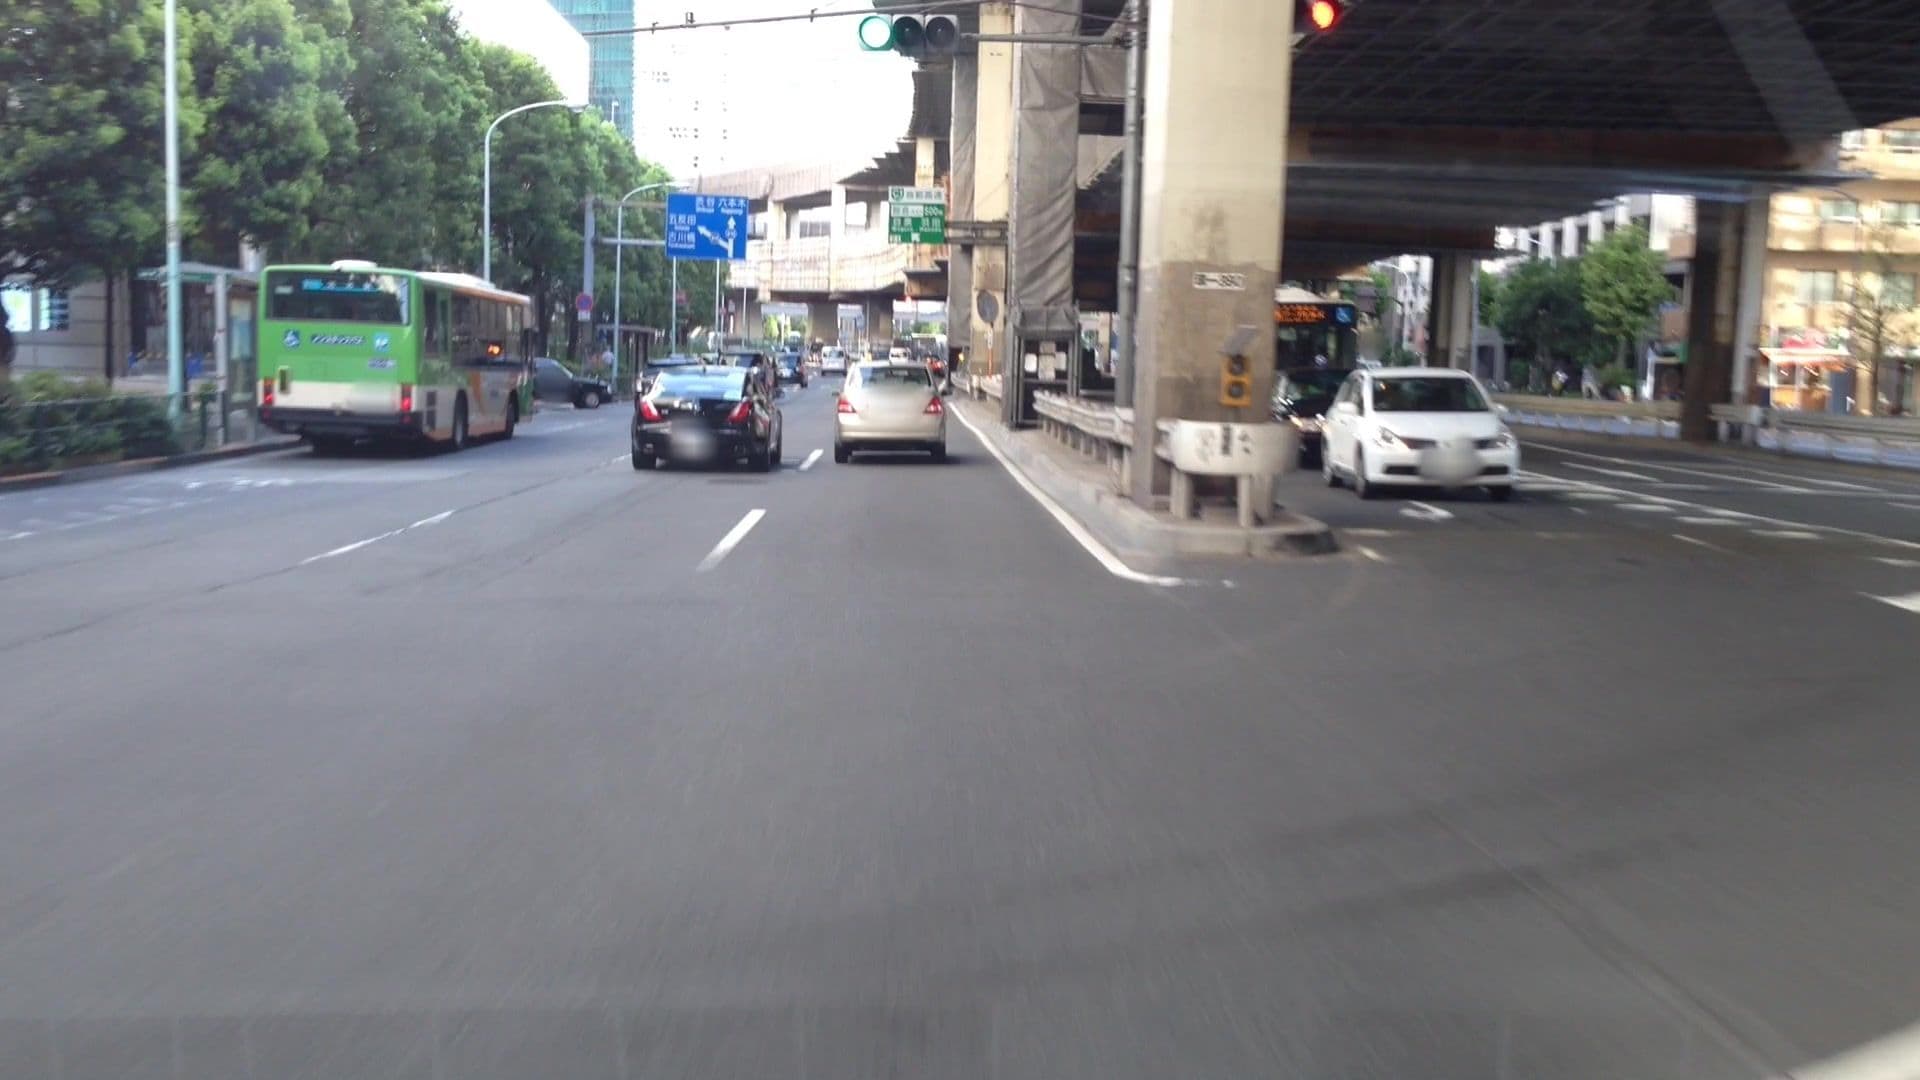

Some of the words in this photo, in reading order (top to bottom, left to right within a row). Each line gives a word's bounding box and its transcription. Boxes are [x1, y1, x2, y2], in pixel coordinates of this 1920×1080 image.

[718, 197, 745, 208] 六本木
[669, 214, 696, 226] 五反田
[668, 231, 696, 242] 古川橋
